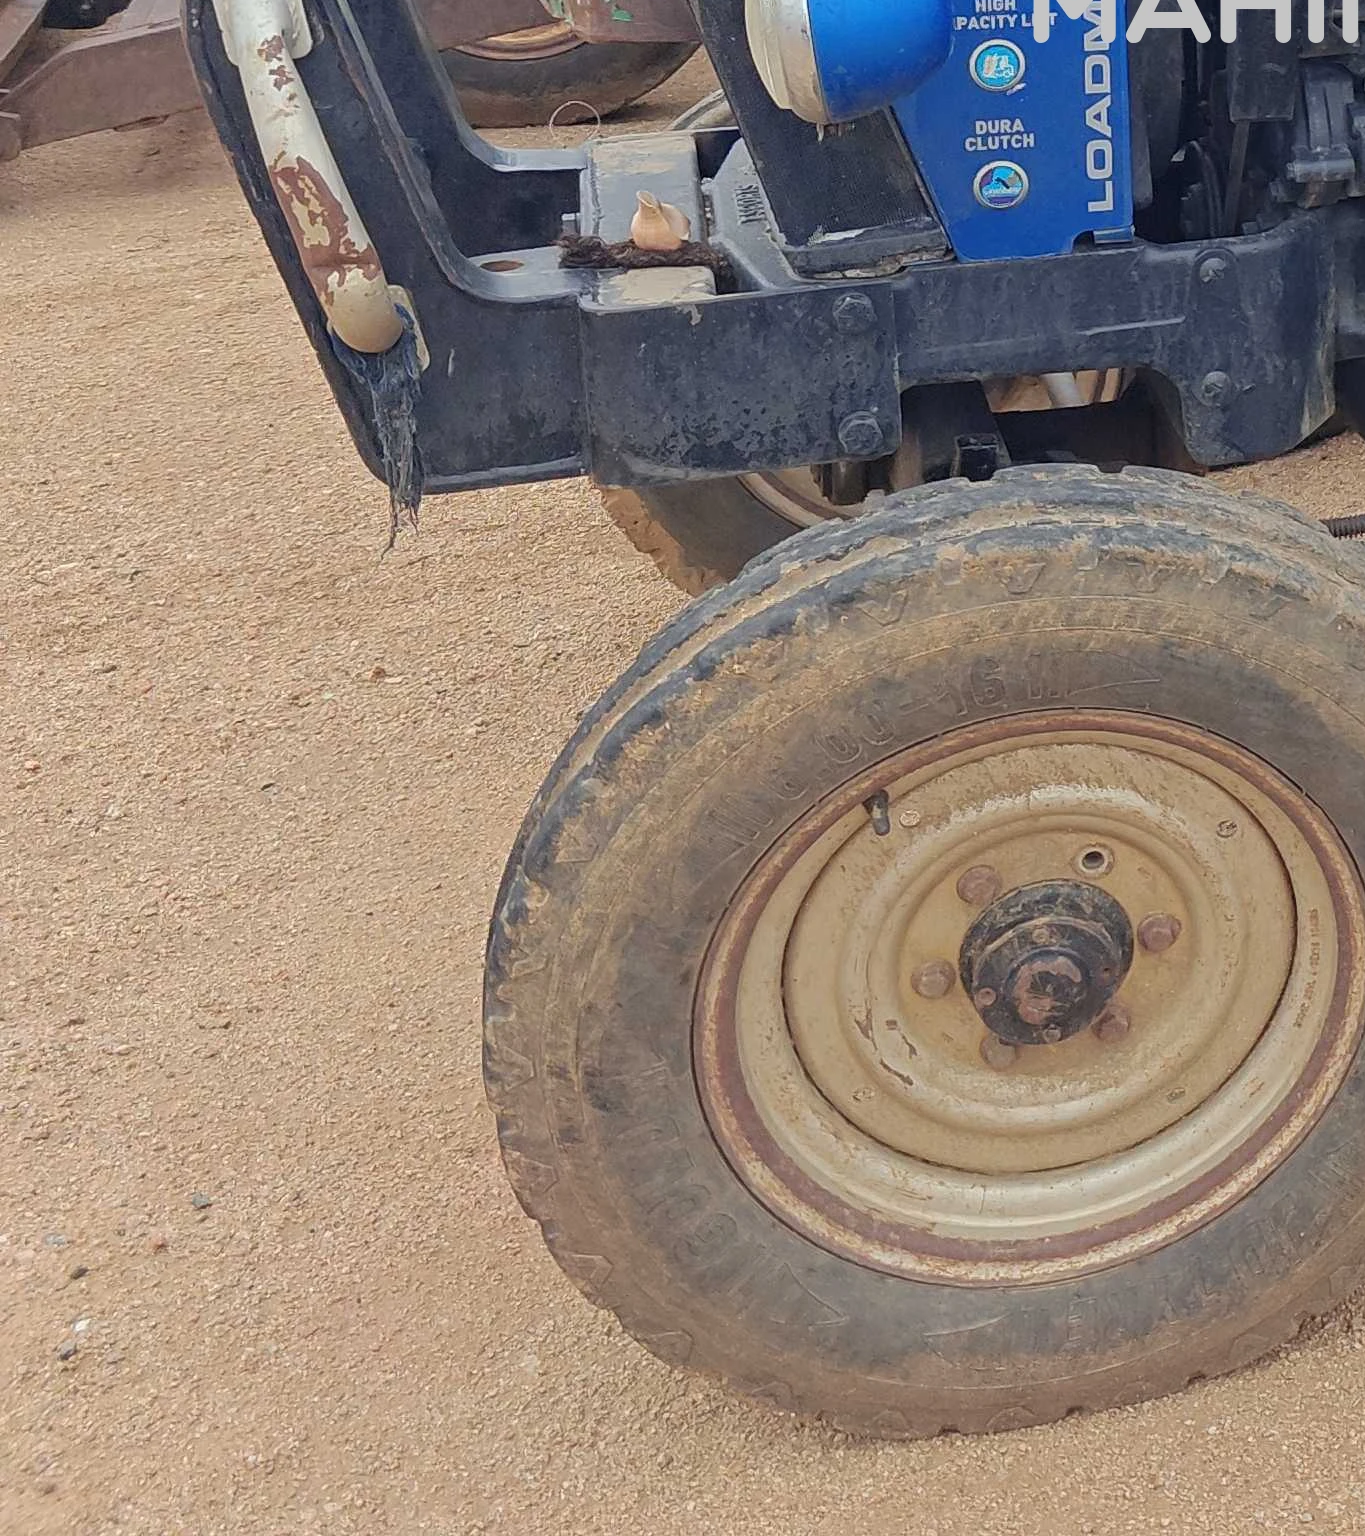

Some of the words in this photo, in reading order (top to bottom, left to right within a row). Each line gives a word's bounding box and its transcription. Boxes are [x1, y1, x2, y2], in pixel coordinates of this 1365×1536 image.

[953, 13, 1018, 31] PACITY
[1021, 11, 1059, 27] LT
[974, 118, 1025, 135] DURA
[964, 132, 1035, 152] CLUTCH
